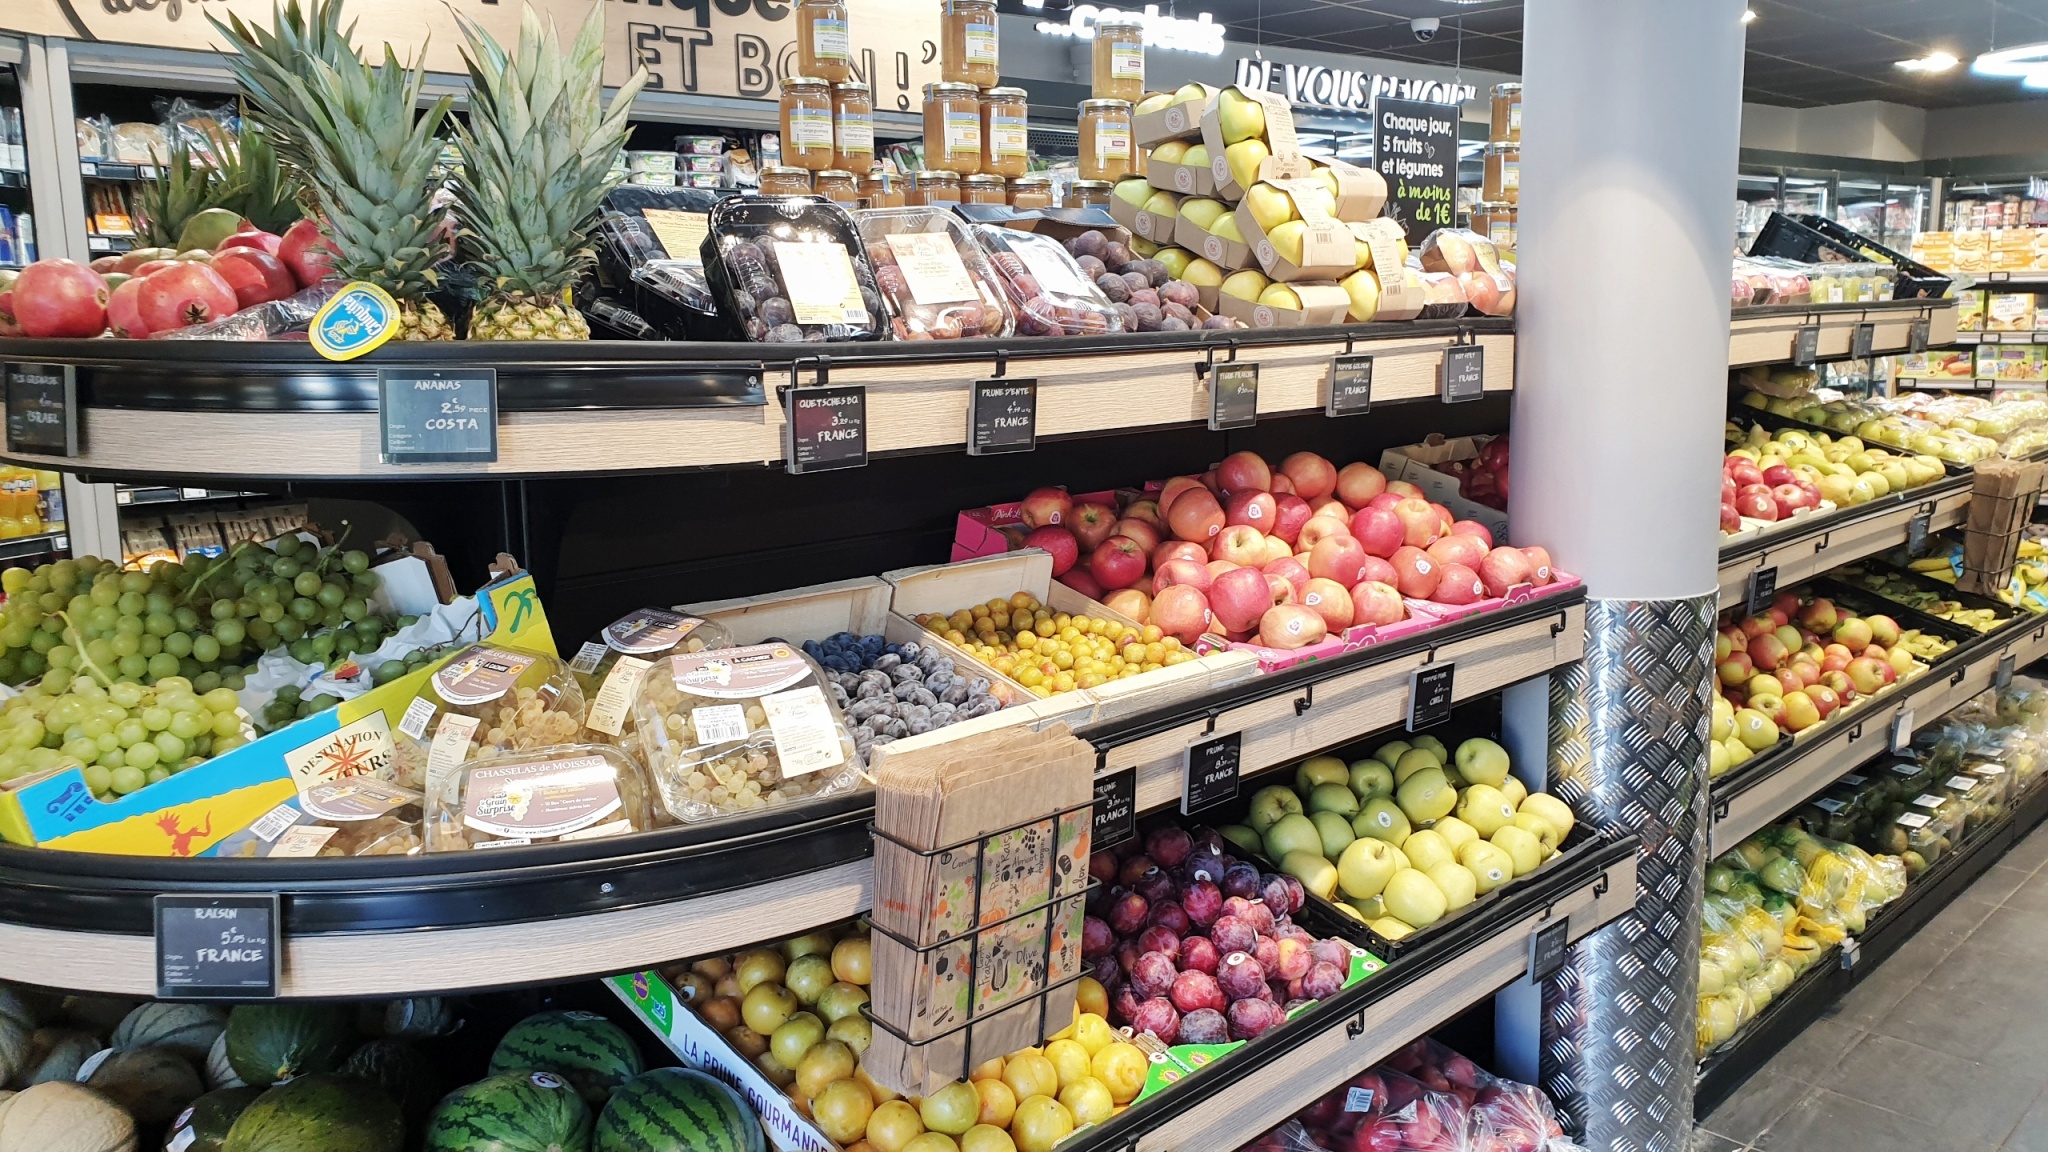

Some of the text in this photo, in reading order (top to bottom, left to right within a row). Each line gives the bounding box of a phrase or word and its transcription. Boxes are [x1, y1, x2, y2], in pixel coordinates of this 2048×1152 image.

[627, 22, 713, 91] ET
[736, 33, 877, 109] BN
[1285, 63, 1371, 109] VOUS
[1383, 111, 1453, 138] Chaque jour,
[1383, 135, 1423, 155] 5 fruits
[1382, 157, 1443, 180] et légumes
[1397, 178, 1450, 201] à moins
[1415, 202, 1450, 225] de 1€
[342, 294, 383, 336] Chiquita
[414, 380, 461, 391] ANANAS
[981, 387, 1029, 397] PRUNE D'ENTE
[799, 398, 846, 408] QUETSCHES
[425, 418, 479, 430] COSTA
[994, 416, 1029, 428] FRANCE
[817, 428, 859, 442] FRANCE
[992, 507, 1013, 522] Pink
[676, 648, 730, 661] CHASSELAS
[299, 730, 383, 776] DESTINATION
[1206, 744, 1225, 756] PRUNE
[475, 758, 601, 779] CHASSELAS de MOISSAC
[1205, 766, 1234, 785] FRANCE
[477, 804, 516, 816] Surprise
[485, 799, 508, 807] Grain
[1095, 806, 1129, 827] FRANCE
[1011, 853, 1039, 869] Abricot
[988, 861, 1001, 893] Poire
[194, 908, 238, 919] RAISIN
[196, 948, 264, 962] FRANCE
[1015, 946, 1039, 965] Olive
[977, 952, 992, 987] Fraise
[684, 1033, 829, 1152] LA PRUNE GOURMAND
